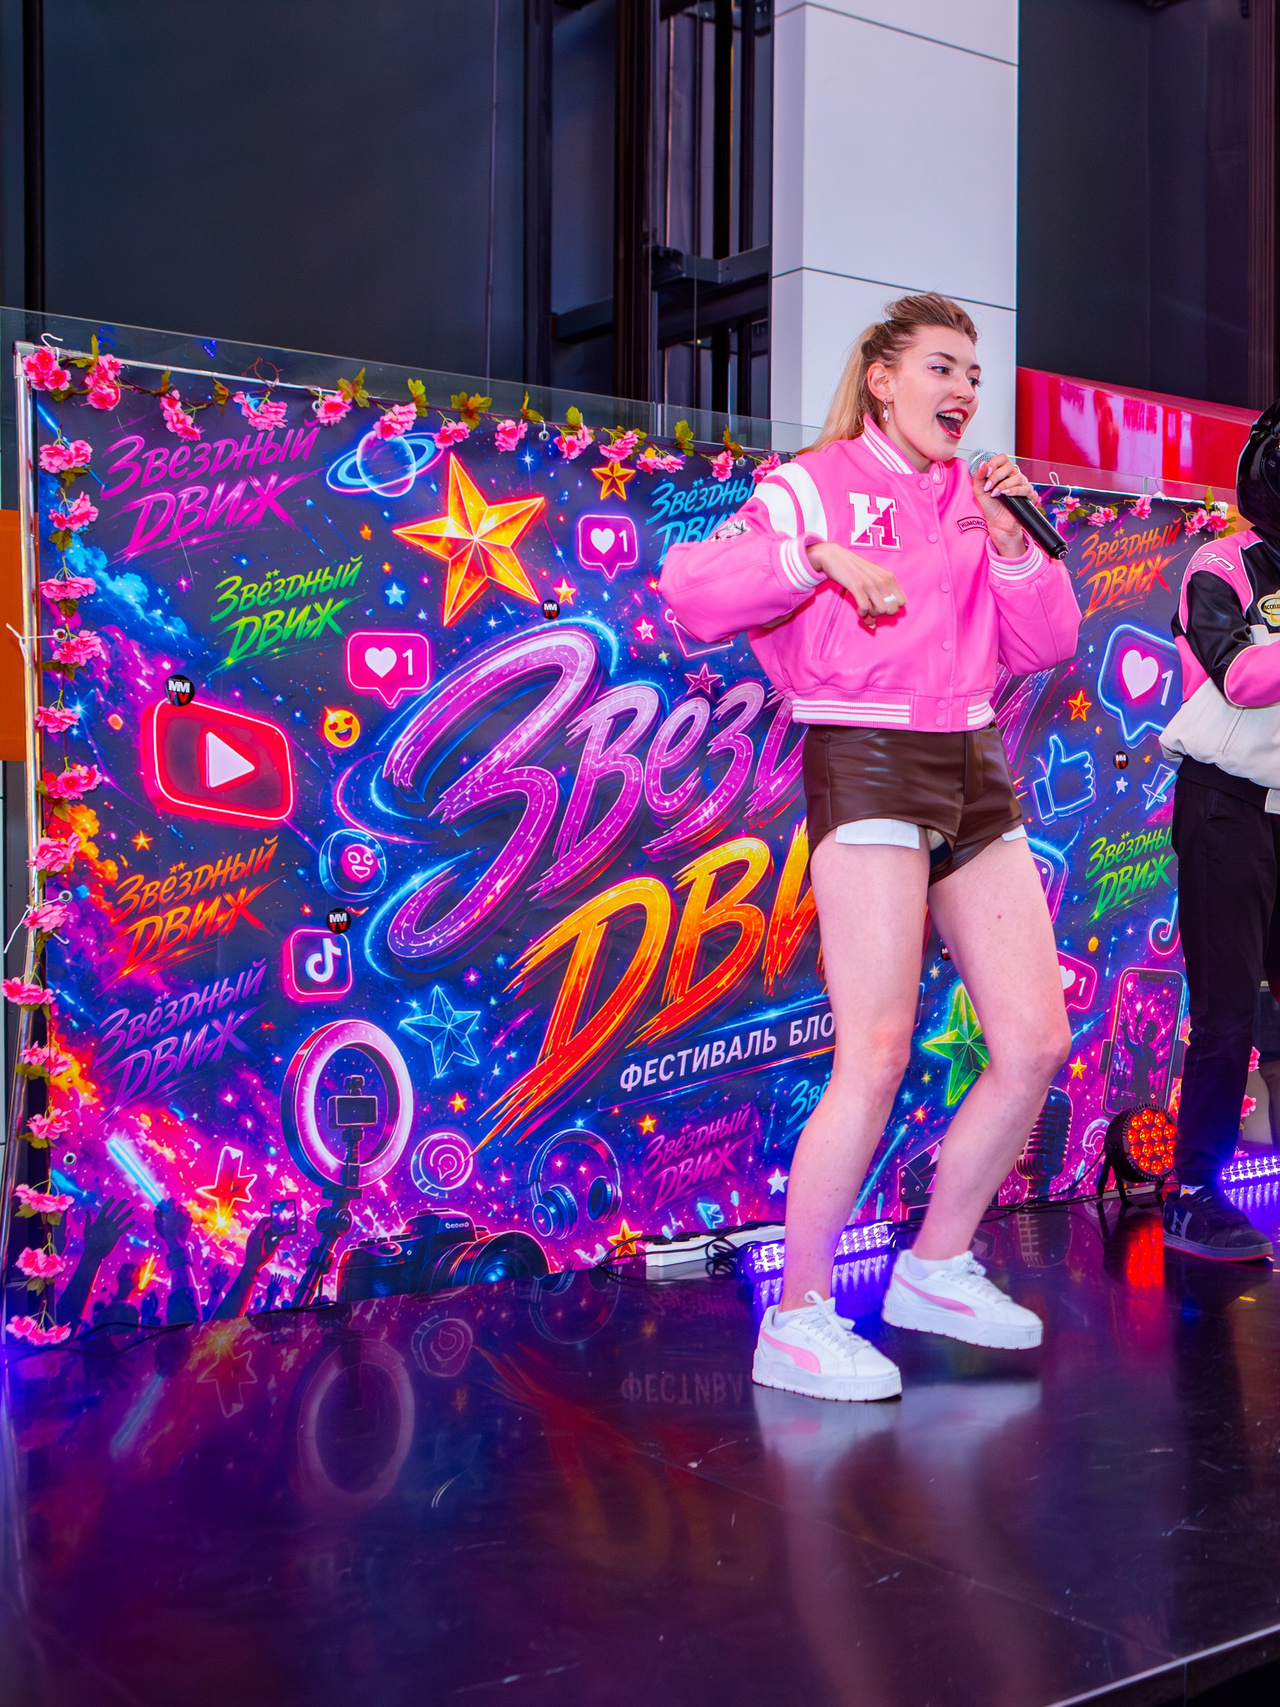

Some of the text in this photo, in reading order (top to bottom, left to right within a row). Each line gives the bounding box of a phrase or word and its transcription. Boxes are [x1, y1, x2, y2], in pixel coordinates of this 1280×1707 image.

[619, 529, 628, 552] 1
[402, 648, 413, 676] 1
[168, 679, 190, 693] MM
[1160, 669, 1173, 706] 1
[329, 912, 348, 923] MM
[330, 921, 347, 931] TV
[1078, 976, 1087, 997] 1
[620, 1012, 836, 1092] ФЕСТИВАЛЬ БЛО
